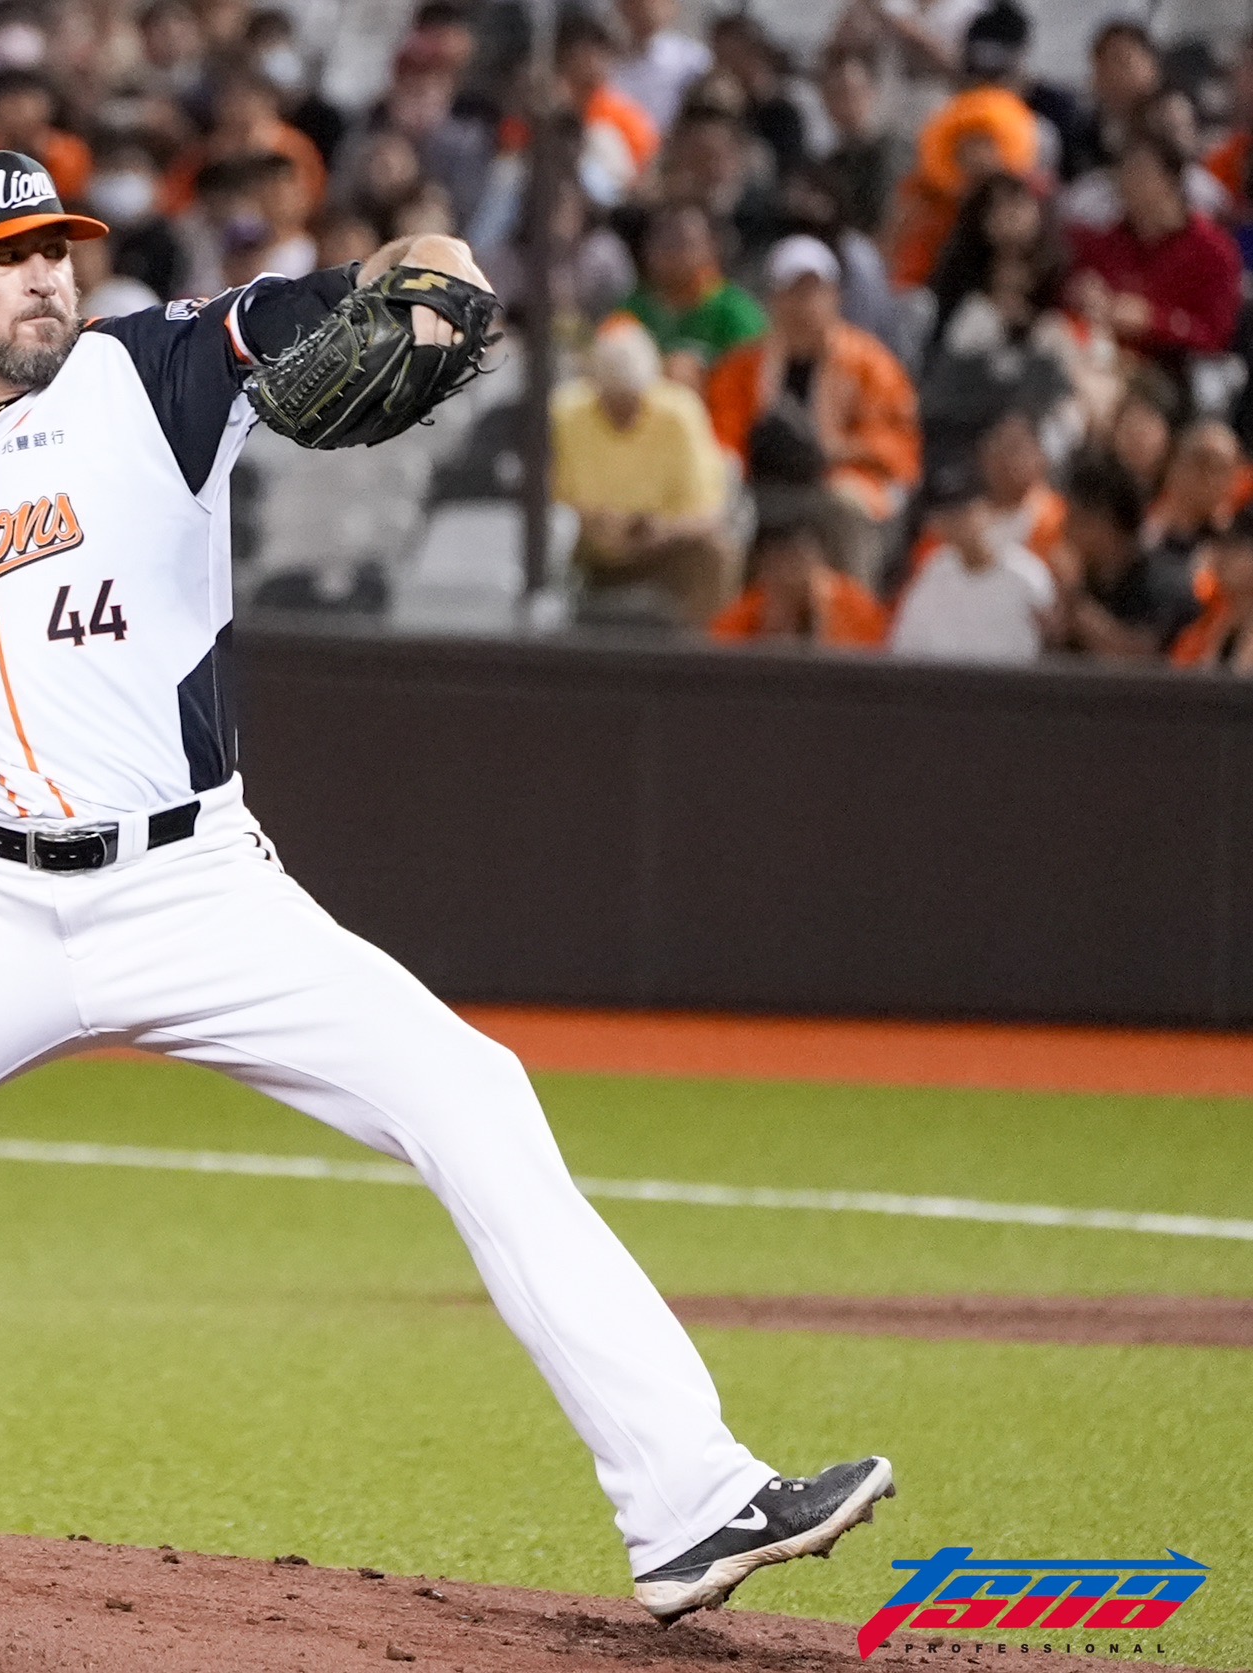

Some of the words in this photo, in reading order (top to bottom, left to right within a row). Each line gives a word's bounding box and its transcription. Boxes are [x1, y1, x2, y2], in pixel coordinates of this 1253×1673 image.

[1, 429, 65, 455] 兆豐銀行
[47, 579, 128, 647] 44
